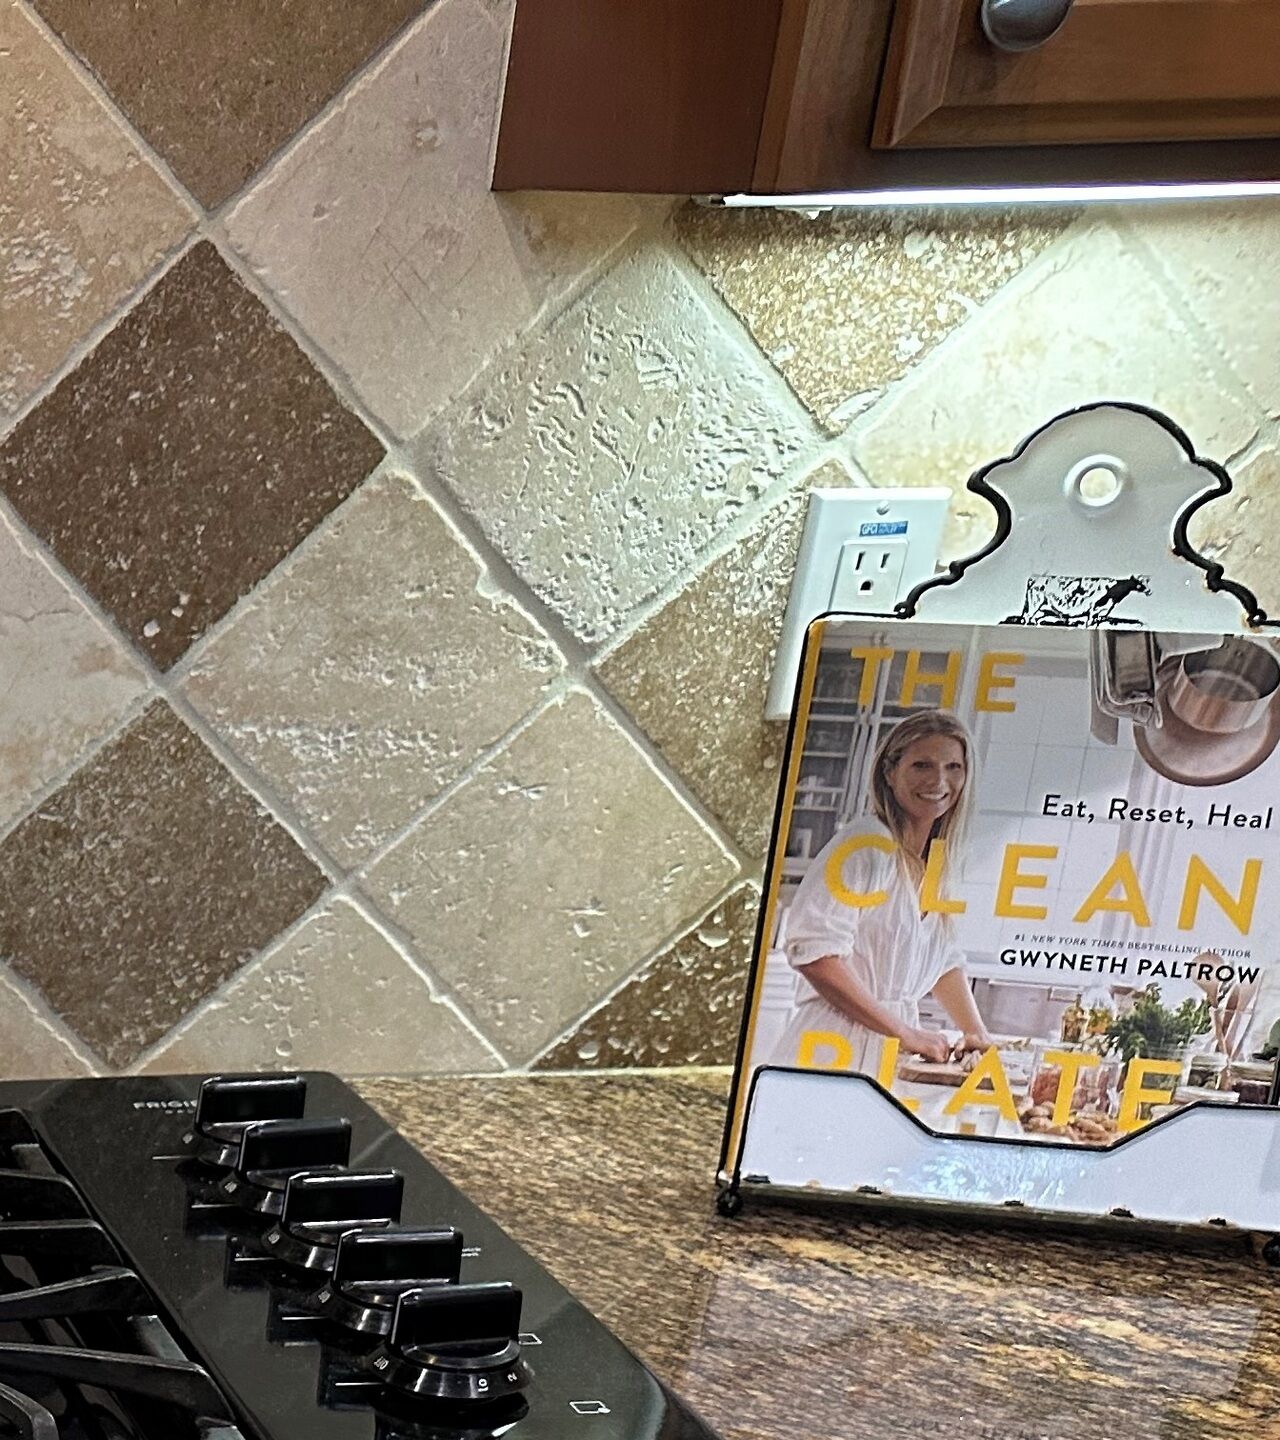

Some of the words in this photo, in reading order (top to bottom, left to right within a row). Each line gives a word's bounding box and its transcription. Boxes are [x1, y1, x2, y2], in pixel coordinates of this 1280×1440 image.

[851, 647, 1026, 713] THE
[1042, 793, 1095, 823] Eat,
[1108, 797, 1194, 829] Reset,
[1207, 803, 1273, 829] Heal
[823, 833, 1263, 936] CLEAN
[1031, 934, 1056, 944] NEW
[1058, 936, 1087, 947] YORK
[1091, 938, 1125, 949] TIMES
[1127, 941, 1201, 955] BESTSELLING
[1000, 948, 1128, 975] GWYNETH
[1136, 958, 1260, 984] PALTROW
